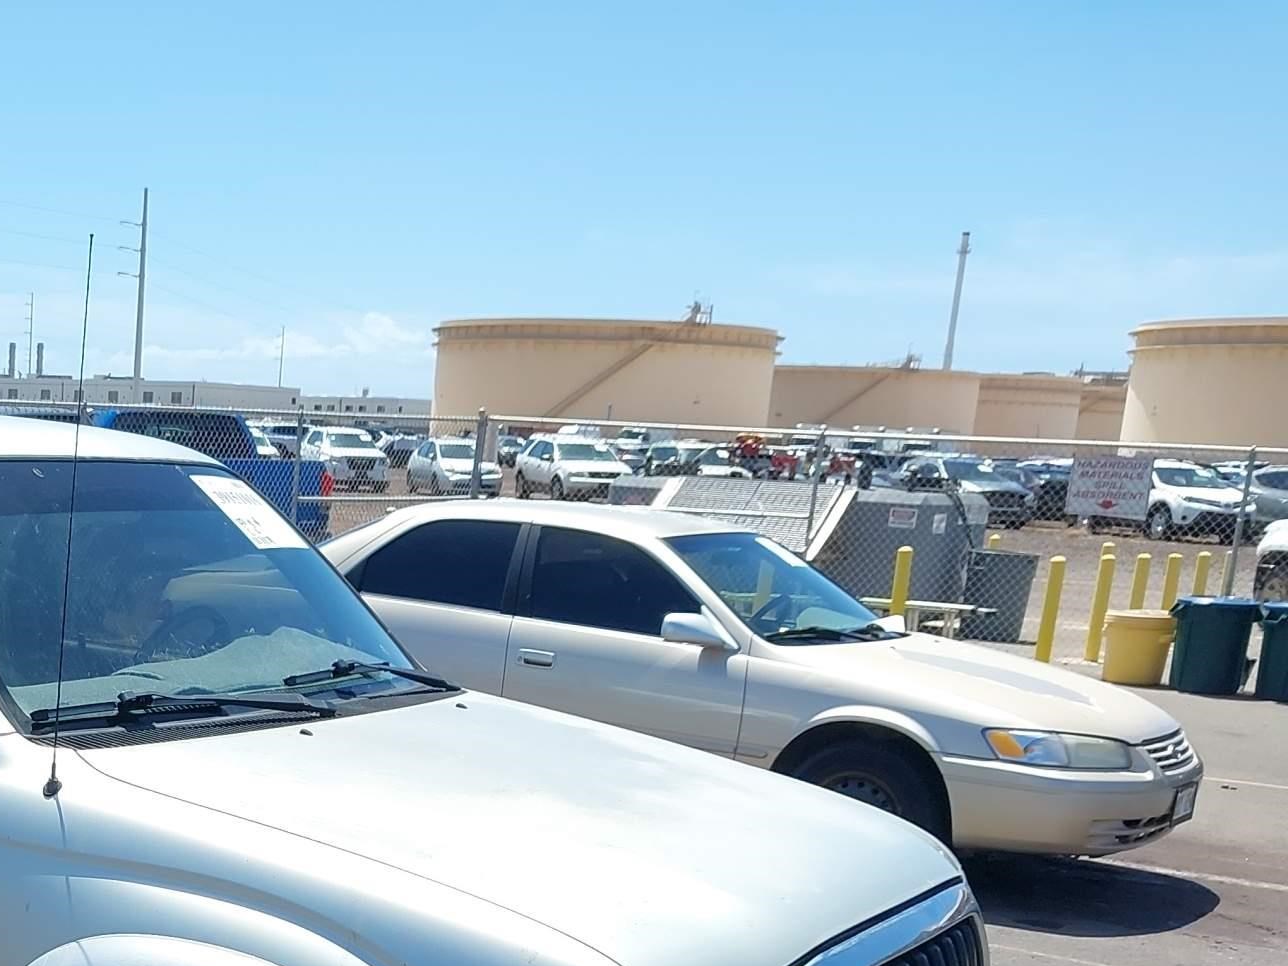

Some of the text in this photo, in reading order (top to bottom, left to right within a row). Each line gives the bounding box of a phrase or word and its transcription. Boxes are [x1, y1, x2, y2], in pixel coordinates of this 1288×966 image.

[1076, 460, 1149, 471] HAZARDOUS
[1078, 470, 1145, 480] MATERIALS
[1094, 480, 1127, 489] SPILL
[1072, 489, 1146, 500] ABSORBENT
